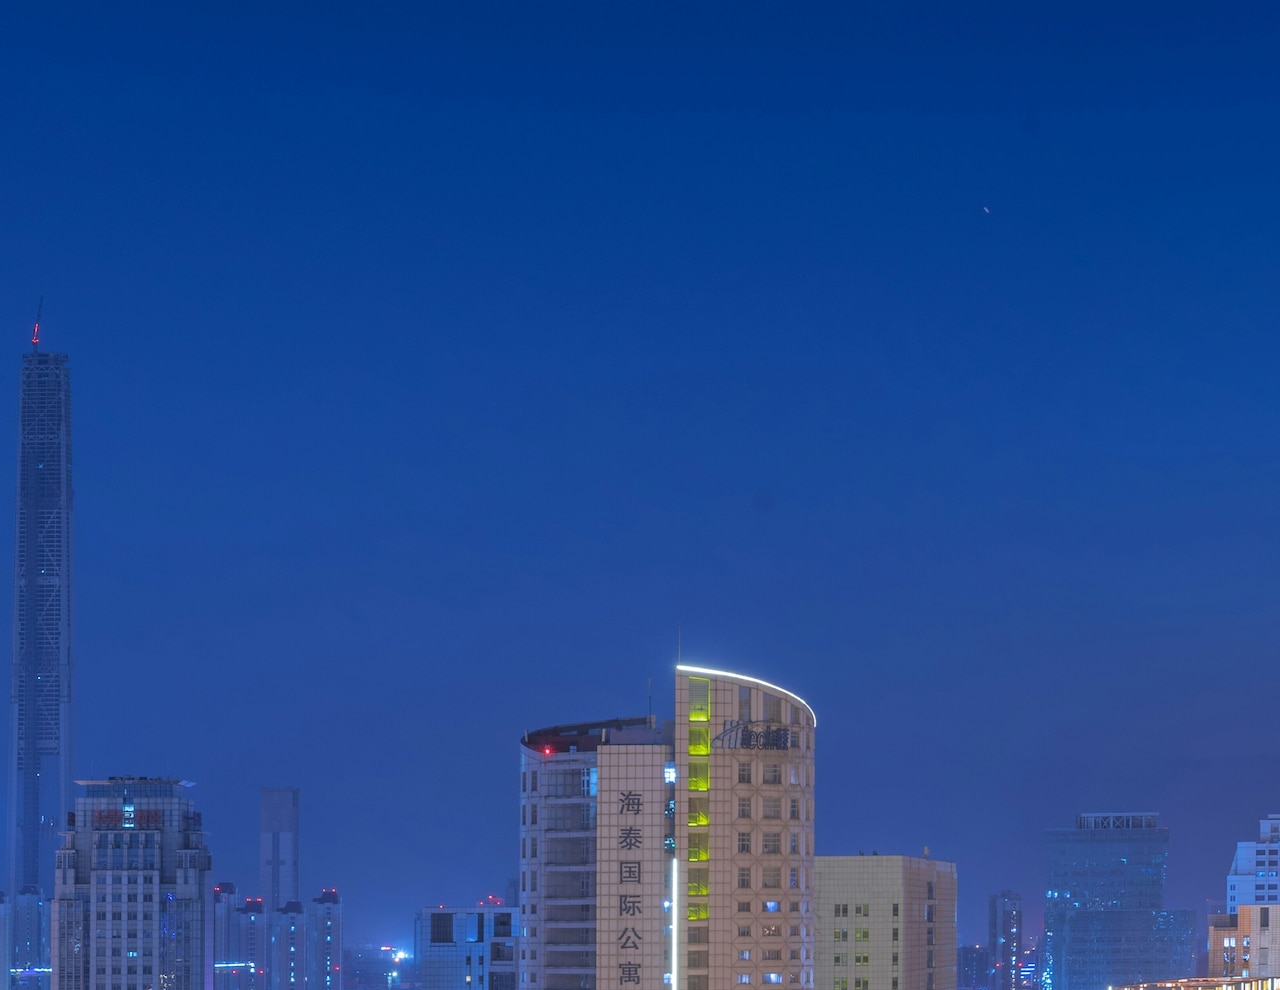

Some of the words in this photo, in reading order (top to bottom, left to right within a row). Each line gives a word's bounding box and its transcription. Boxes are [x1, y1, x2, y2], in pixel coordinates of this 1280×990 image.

[618, 791, 643, 986] 海泰国际公寓
